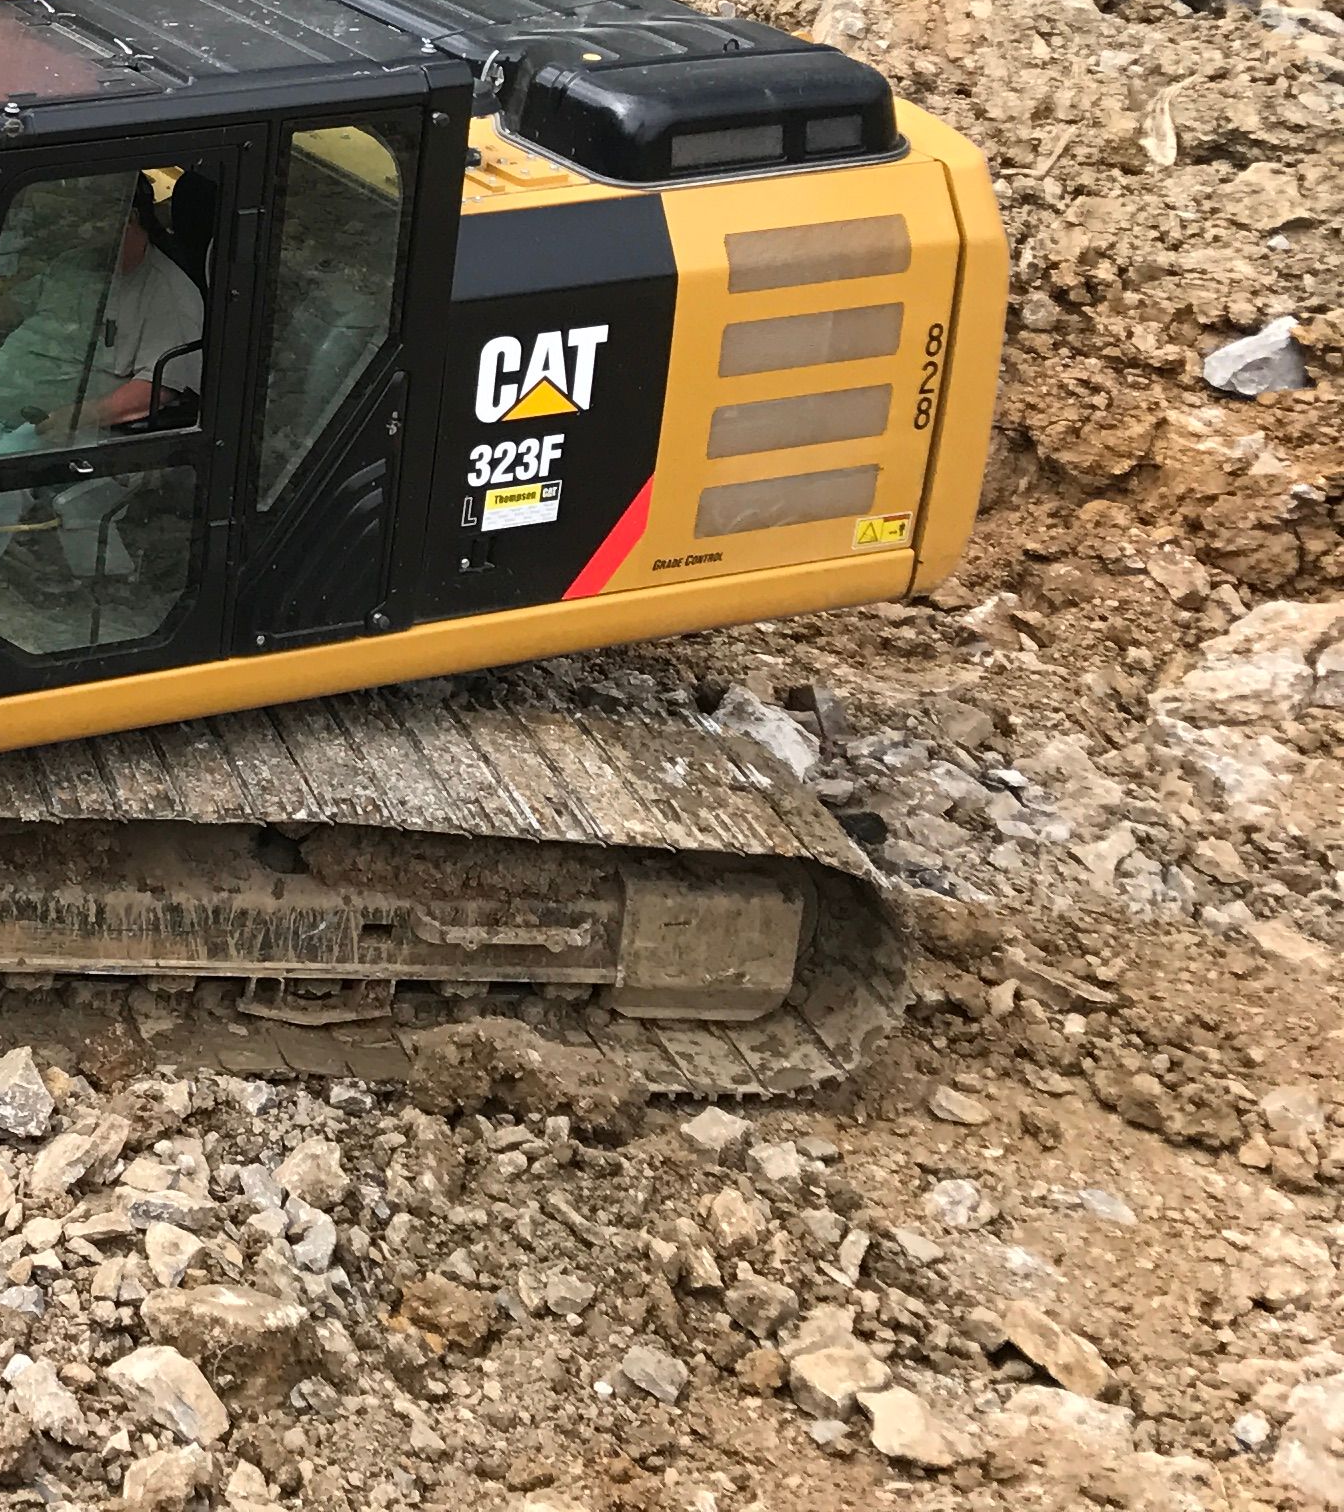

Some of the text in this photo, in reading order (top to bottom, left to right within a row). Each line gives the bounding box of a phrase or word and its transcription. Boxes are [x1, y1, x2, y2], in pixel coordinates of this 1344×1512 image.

[475, 324, 609, 424] CAT
[913, 322, 944, 430] 828
[467, 433, 565, 487] 323F
[460, 495, 478, 527] L
[494, 485, 559, 505] Thompson CAT
